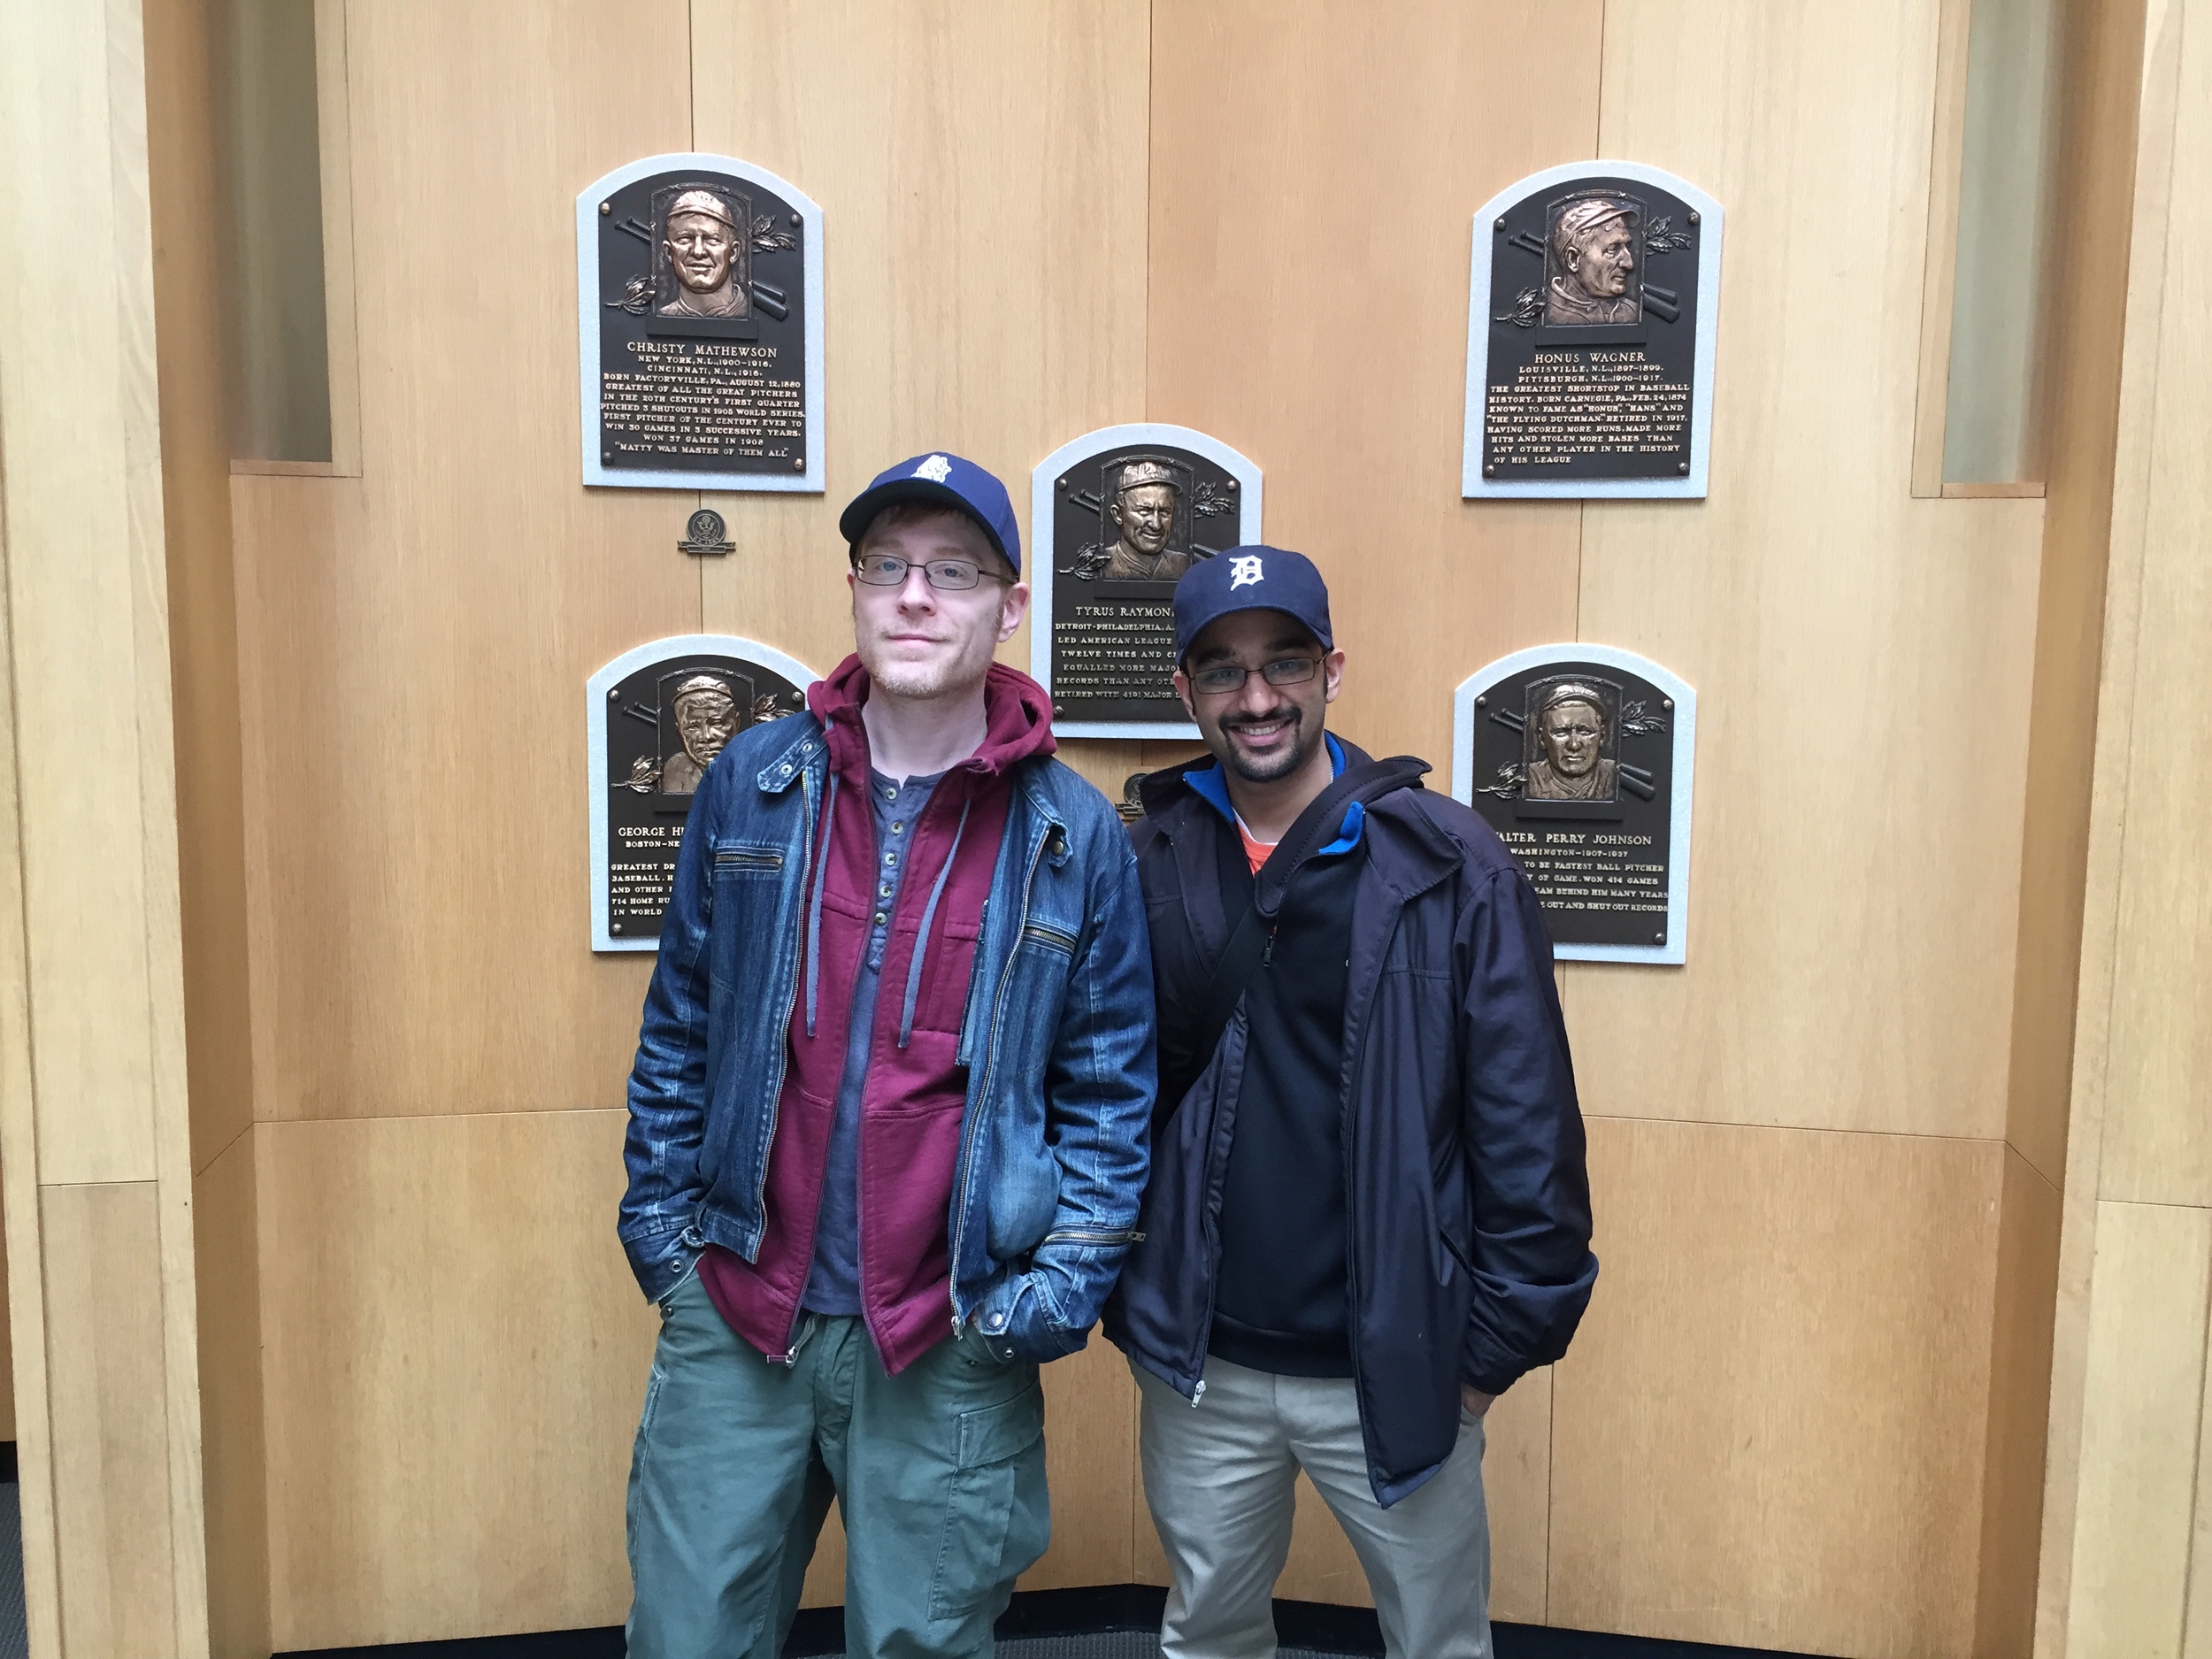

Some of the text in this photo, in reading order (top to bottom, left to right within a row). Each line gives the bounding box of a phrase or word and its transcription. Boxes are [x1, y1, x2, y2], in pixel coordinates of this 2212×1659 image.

[627, 342, 777, 357] CHRISTY MATHEWSON
[1535, 353, 1646, 363] HONUS WAGNER
[606, 383, 653, 392] GREATEST
[751, 389, 797, 397] PITCHERS
[670, 396, 719, 404] CENTURY'S
[652, 405, 698, 413] SHUTOUTS
[1626, 403, 1660, 412] "HANS"
[706, 427, 762, 435] SUCCESSIVE
[682, 446, 719, 454] MASTER
[1076, 607, 1174, 617] TYRUS RAYMON
[618, 827, 665, 836] GEORGE
[1495, 832, 1652, 845] ALTER PERRY JOHNSON
